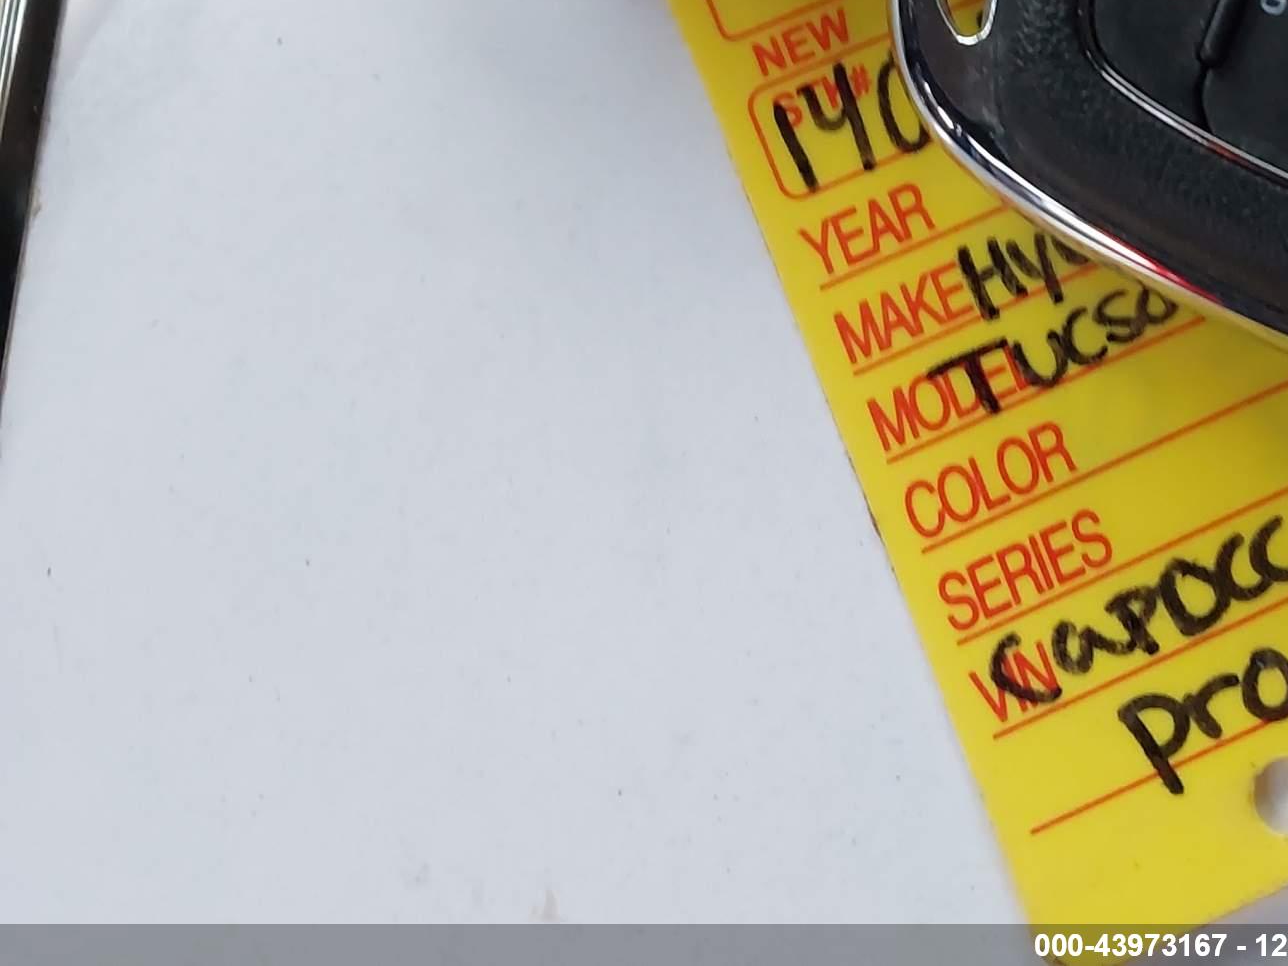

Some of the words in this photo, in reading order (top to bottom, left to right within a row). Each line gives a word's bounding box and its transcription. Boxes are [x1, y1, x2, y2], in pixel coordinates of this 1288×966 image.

[752, 9, 850, 76] NEW
[798, 183, 936, 276] YEAR
[834, 261, 975, 364] MAKE
[866, 342, 1036, 452] MODEL
[905, 420, 1077, 539] COLOR
[938, 509, 1114, 632] SERIES
